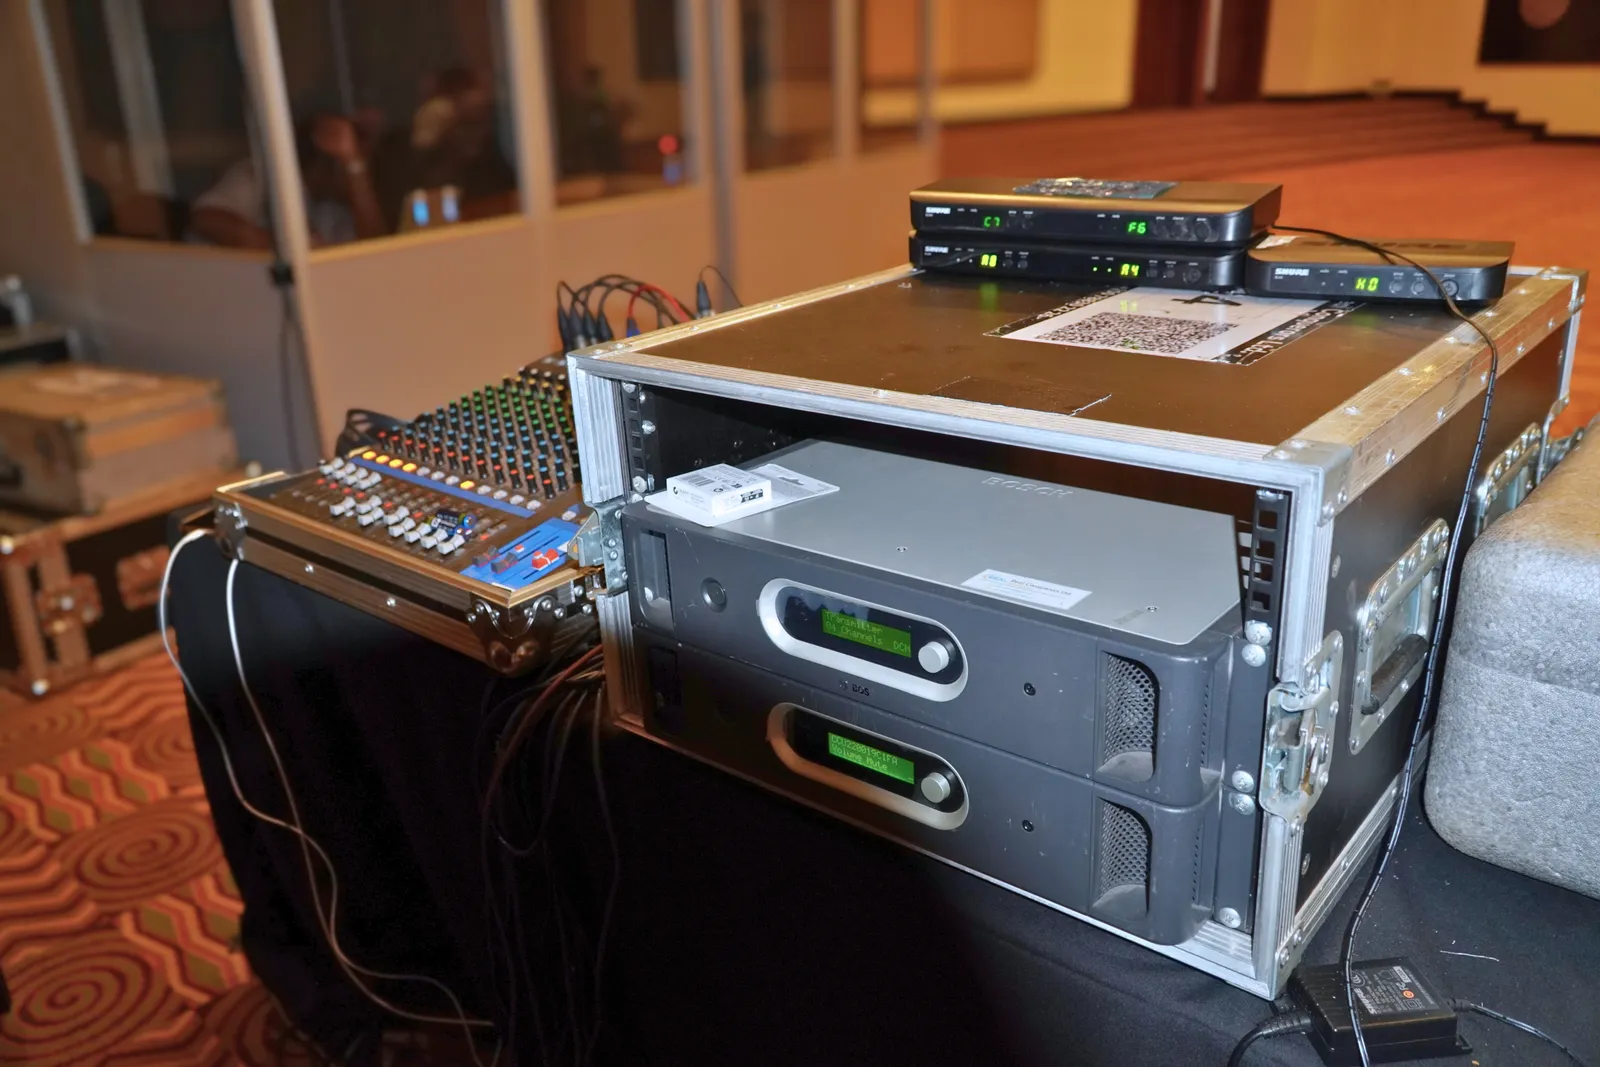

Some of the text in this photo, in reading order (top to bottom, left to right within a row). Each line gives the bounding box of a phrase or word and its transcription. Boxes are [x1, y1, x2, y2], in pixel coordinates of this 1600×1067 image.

[983, 216, 1001, 228] C7
[1127, 221, 1147, 235] F6
[1120, 263, 1140, 277] A4
[1274, 267, 1310, 276] SHURE
[981, 476, 1074, 499] BOSCH
[825, 611, 883, 634] Transmitter
[840, 625, 884, 645] Channels
[893, 640, 911, 653] DCN
[831, 743, 888, 771] Volume Mute
